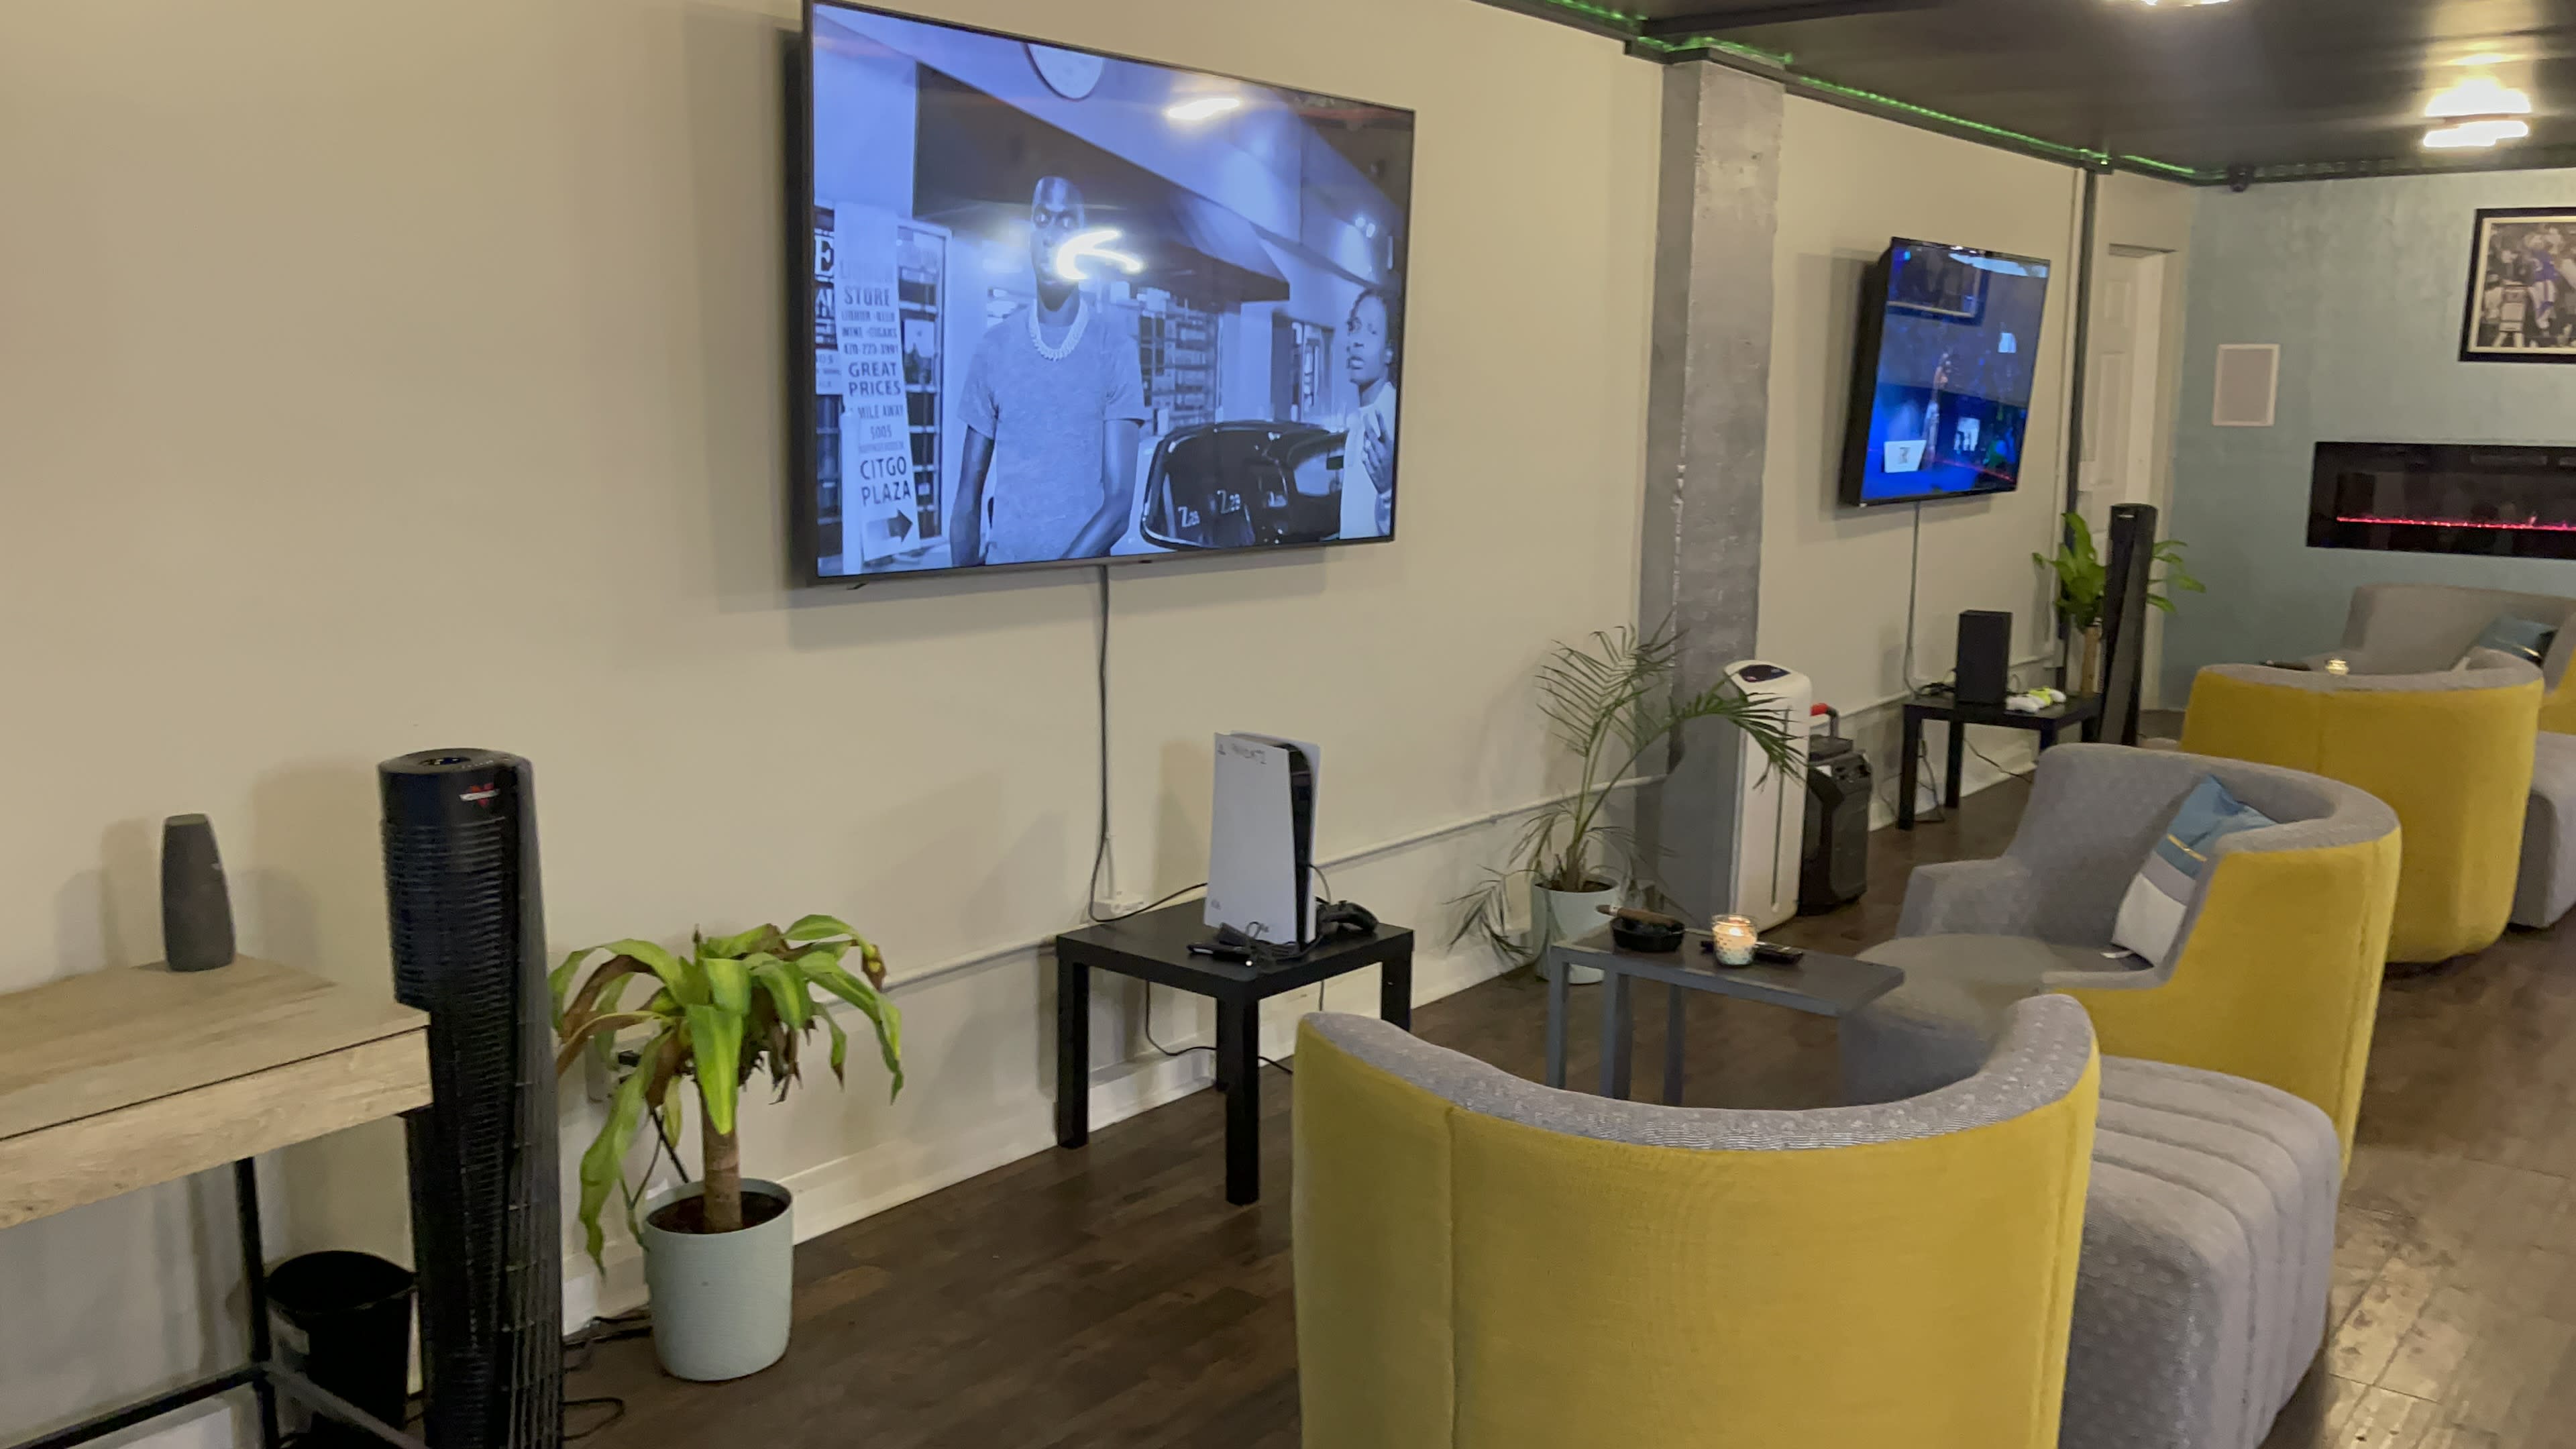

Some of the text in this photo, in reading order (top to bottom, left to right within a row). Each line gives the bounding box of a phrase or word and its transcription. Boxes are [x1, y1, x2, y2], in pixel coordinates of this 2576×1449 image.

[844, 286, 890, 307] STORE
[848, 362, 897, 378] GREAT
[848, 380, 902, 398] PRICES
[858, 405, 904, 419] MILE AWAY
[860, 456, 907, 480] CITGO
[861, 480, 912, 507] PLAZA
